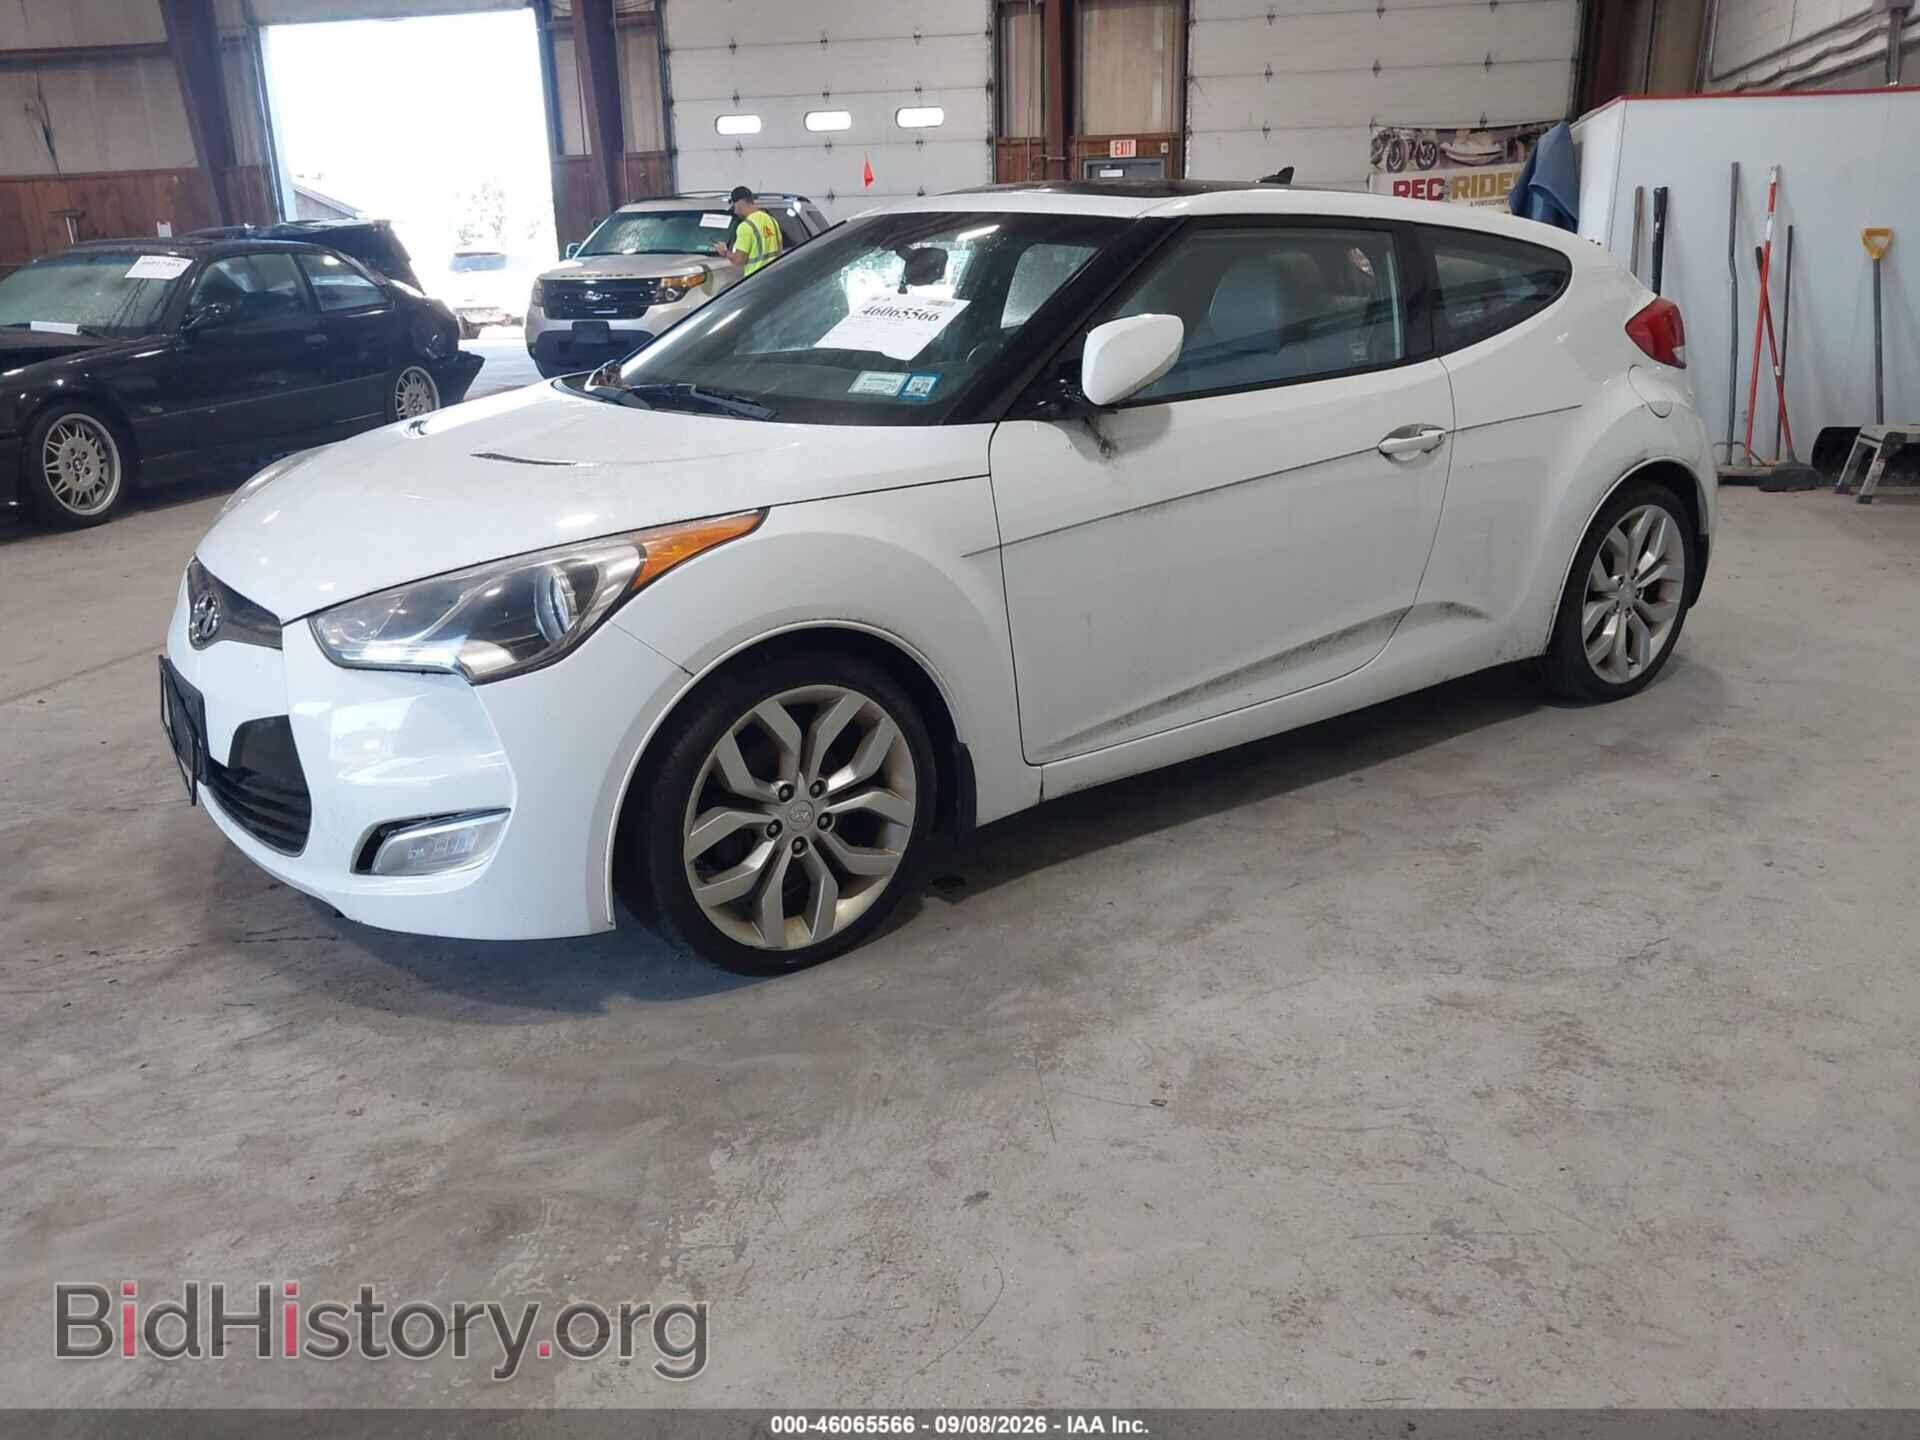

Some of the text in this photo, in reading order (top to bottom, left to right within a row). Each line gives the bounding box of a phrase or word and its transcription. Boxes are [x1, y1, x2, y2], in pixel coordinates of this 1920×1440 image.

[1114, 141, 1133, 155] EXIT
[1393, 178, 1445, 201] REC
[862, 305, 942, 321] 46065566
